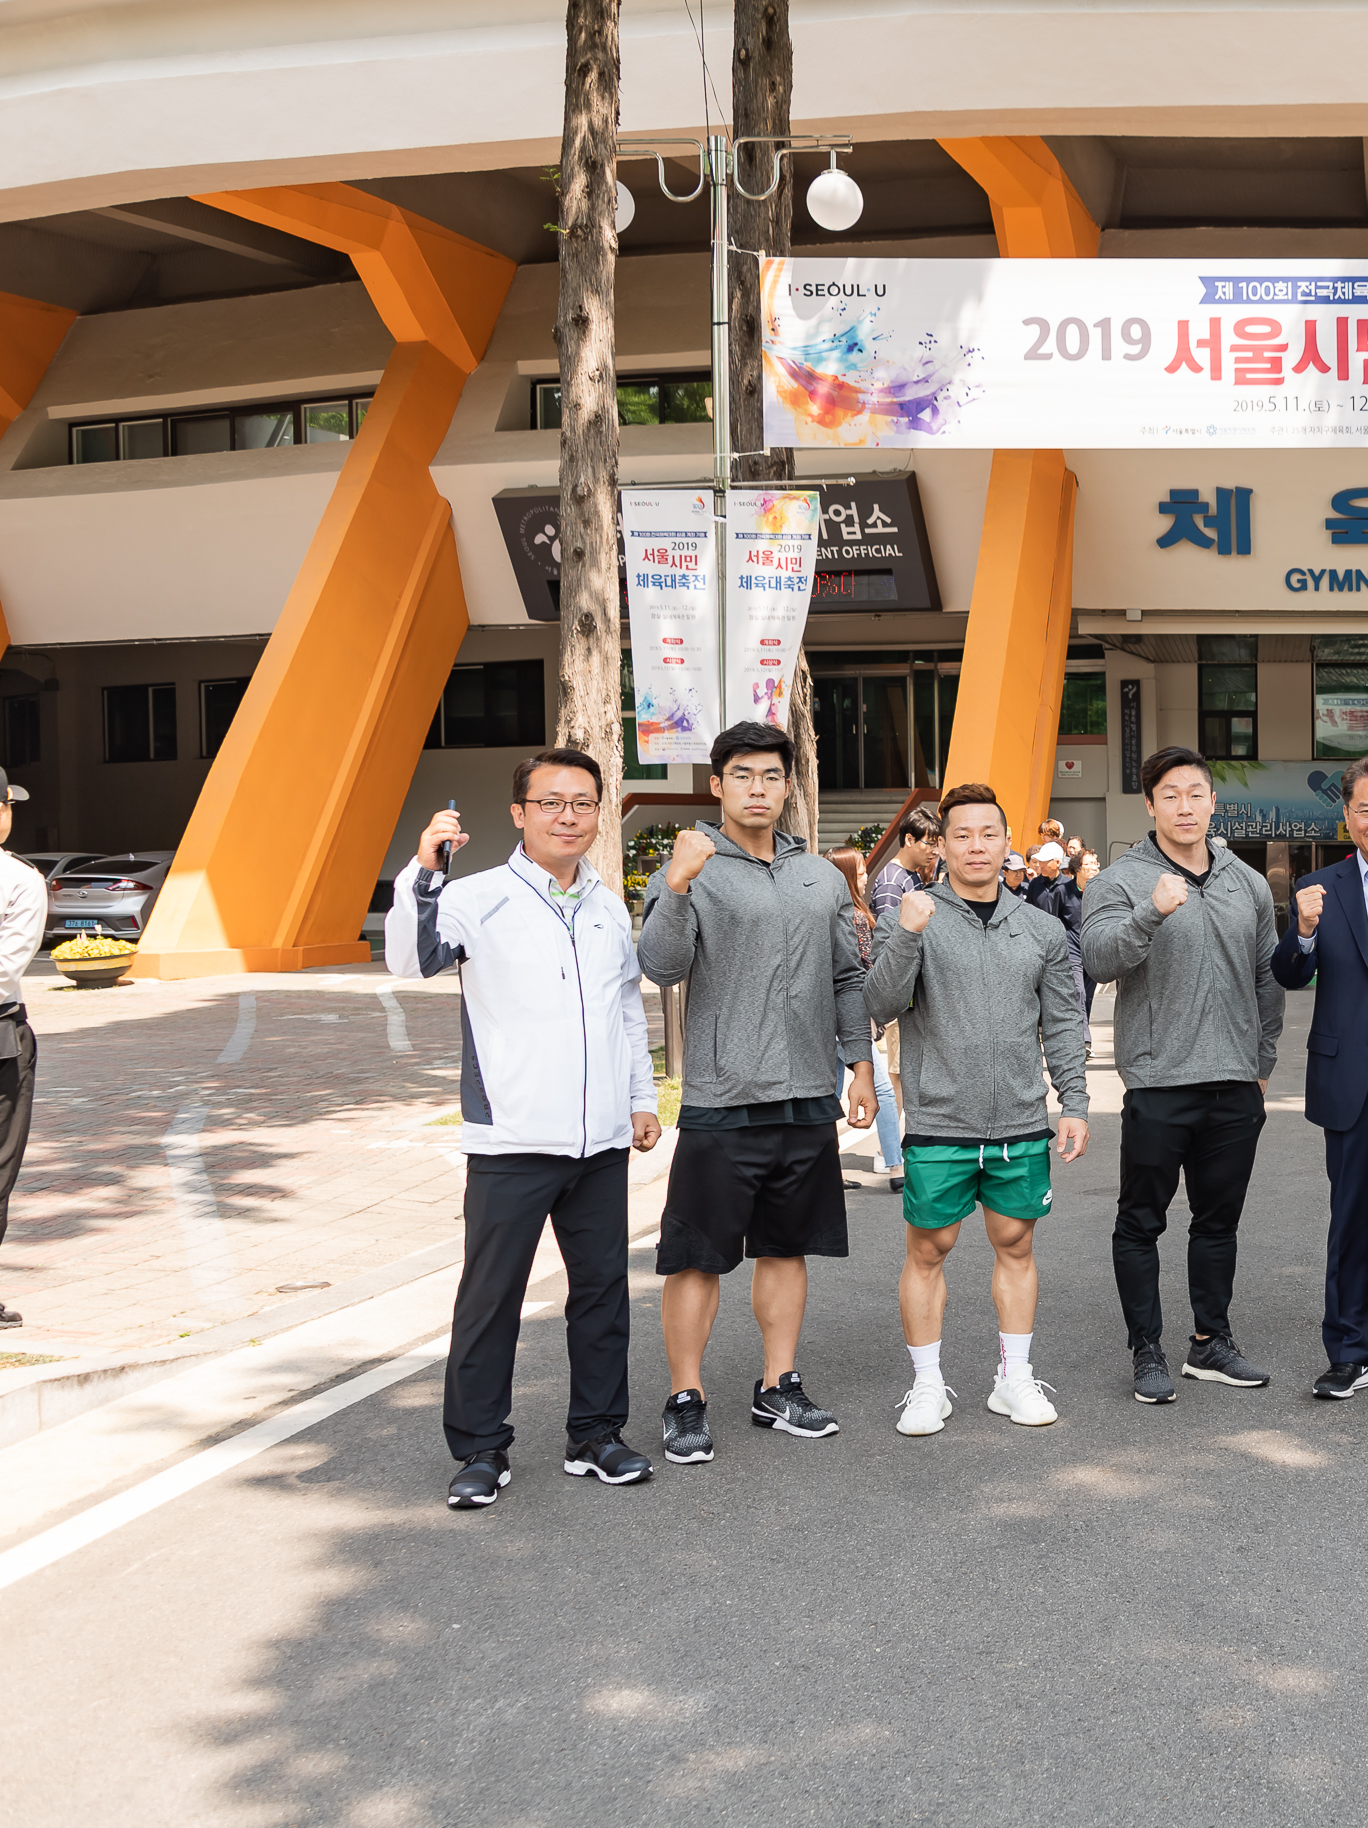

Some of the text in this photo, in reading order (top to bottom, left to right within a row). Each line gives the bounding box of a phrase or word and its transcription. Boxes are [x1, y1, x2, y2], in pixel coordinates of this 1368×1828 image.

[1213, 281, 1233, 301] 제
[1238, 281, 1292, 301] 100회
[1022, 315, 1152, 362] 2019
[1233, 395, 1331, 413] 2019.5.11.(토)
[671, 541, 697, 551] 2019
[777, 543, 802, 554] 2019
[842, 544, 904, 559] OFFICIAL
[636, 573, 706, 590] 체육대축전
[738, 575, 808, 592] 체육대축전
